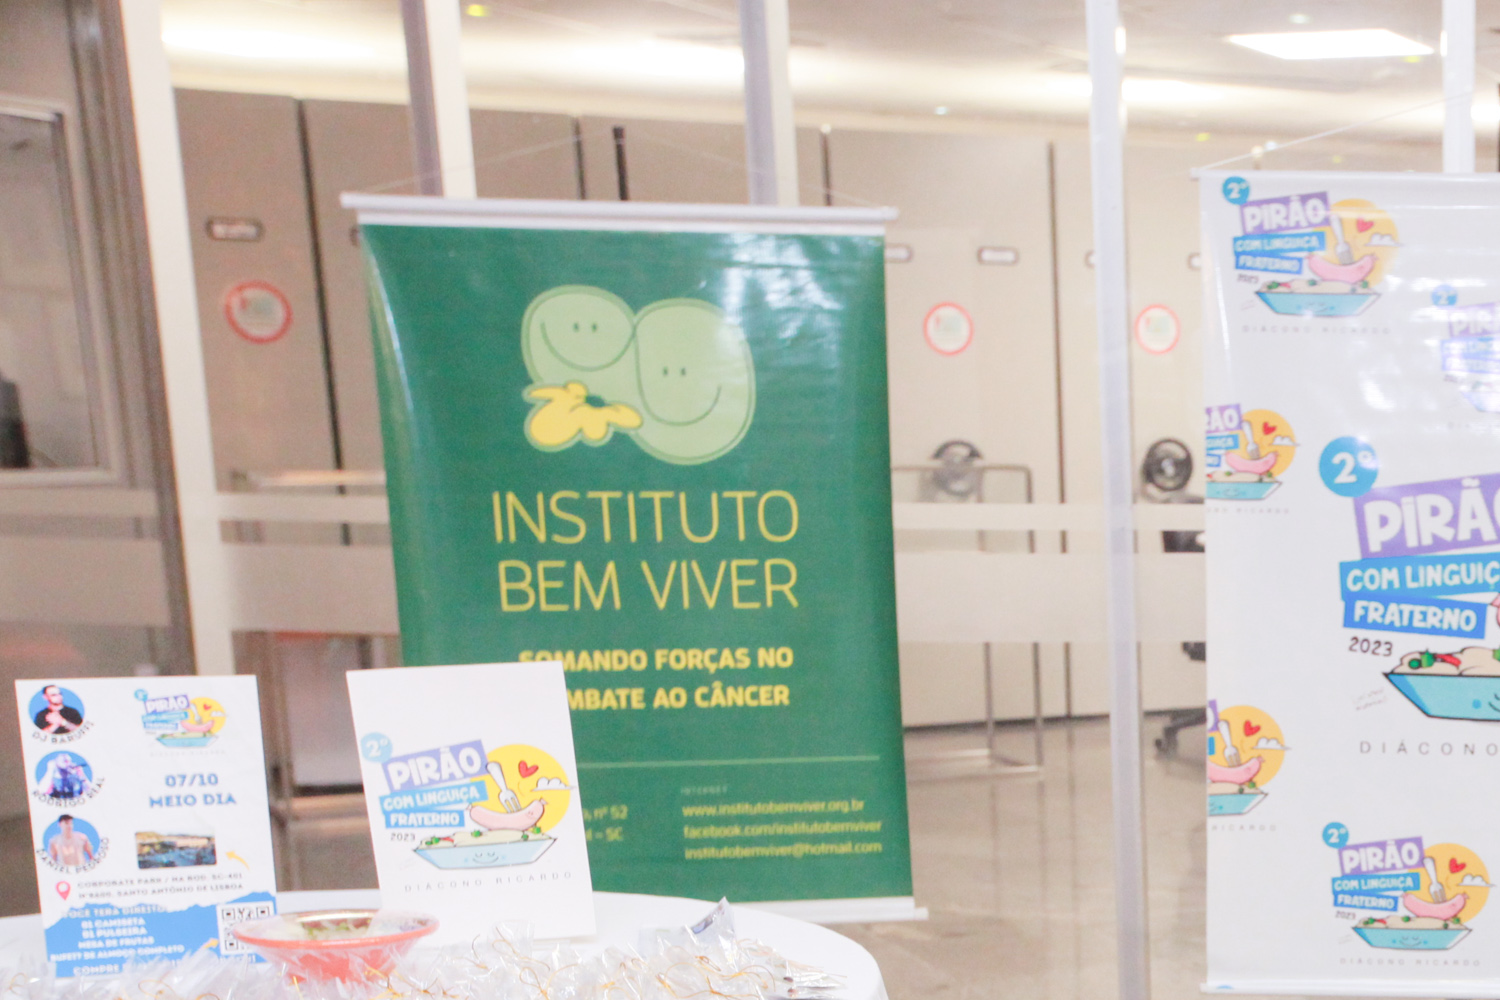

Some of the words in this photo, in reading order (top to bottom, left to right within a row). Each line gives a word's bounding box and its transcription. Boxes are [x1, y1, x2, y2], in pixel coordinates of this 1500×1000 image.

[1243, 195, 1326, 232] PIRÃO
[1235, 238, 1262, 252] COM
[1330, 449, 1375, 485] 2º
[492, 489, 799, 544] INSTITUTO
[498, 558, 622, 612] BEM
[640, 557, 800, 611] VIVER
[1345, 566, 1400, 592] COM
[1353, 599, 1478, 632] FRATERNO
[1348, 635, 1394, 657] 2023
[654, 647, 750, 675] FORÇAS
[757, 646, 794, 669] NO
[566, 687, 646, 711] MBATE
[653, 687, 688, 709] AO
[694, 680, 790, 708] CÂNCER
[365, 738, 389, 758] 2º
[1359, 738, 1500, 757] DIÁCONO
[386, 745, 482, 791] PIRÃO
[164, 773, 219, 788] 07/10
[148, 793, 198, 808] MEIO
[202, 792, 238, 806] DIA
[383, 793, 415, 812] COM
[415, 784, 481, 808] LINGUIÇA
[390, 811, 460, 828] FRATERNO
[390, 832, 416, 842] 2023
[1327, 827, 1347, 844] 2º
[1341, 840, 1420, 874] PIRÃO
[404, 878, 484, 893] DIÁCONO
[496, 871, 573, 885] RICARDO
[1334, 879, 1360, 892] COM
[1360, 876, 1414, 891] LINGUIÇA
[1337, 893, 1395, 910] FRATERNO
